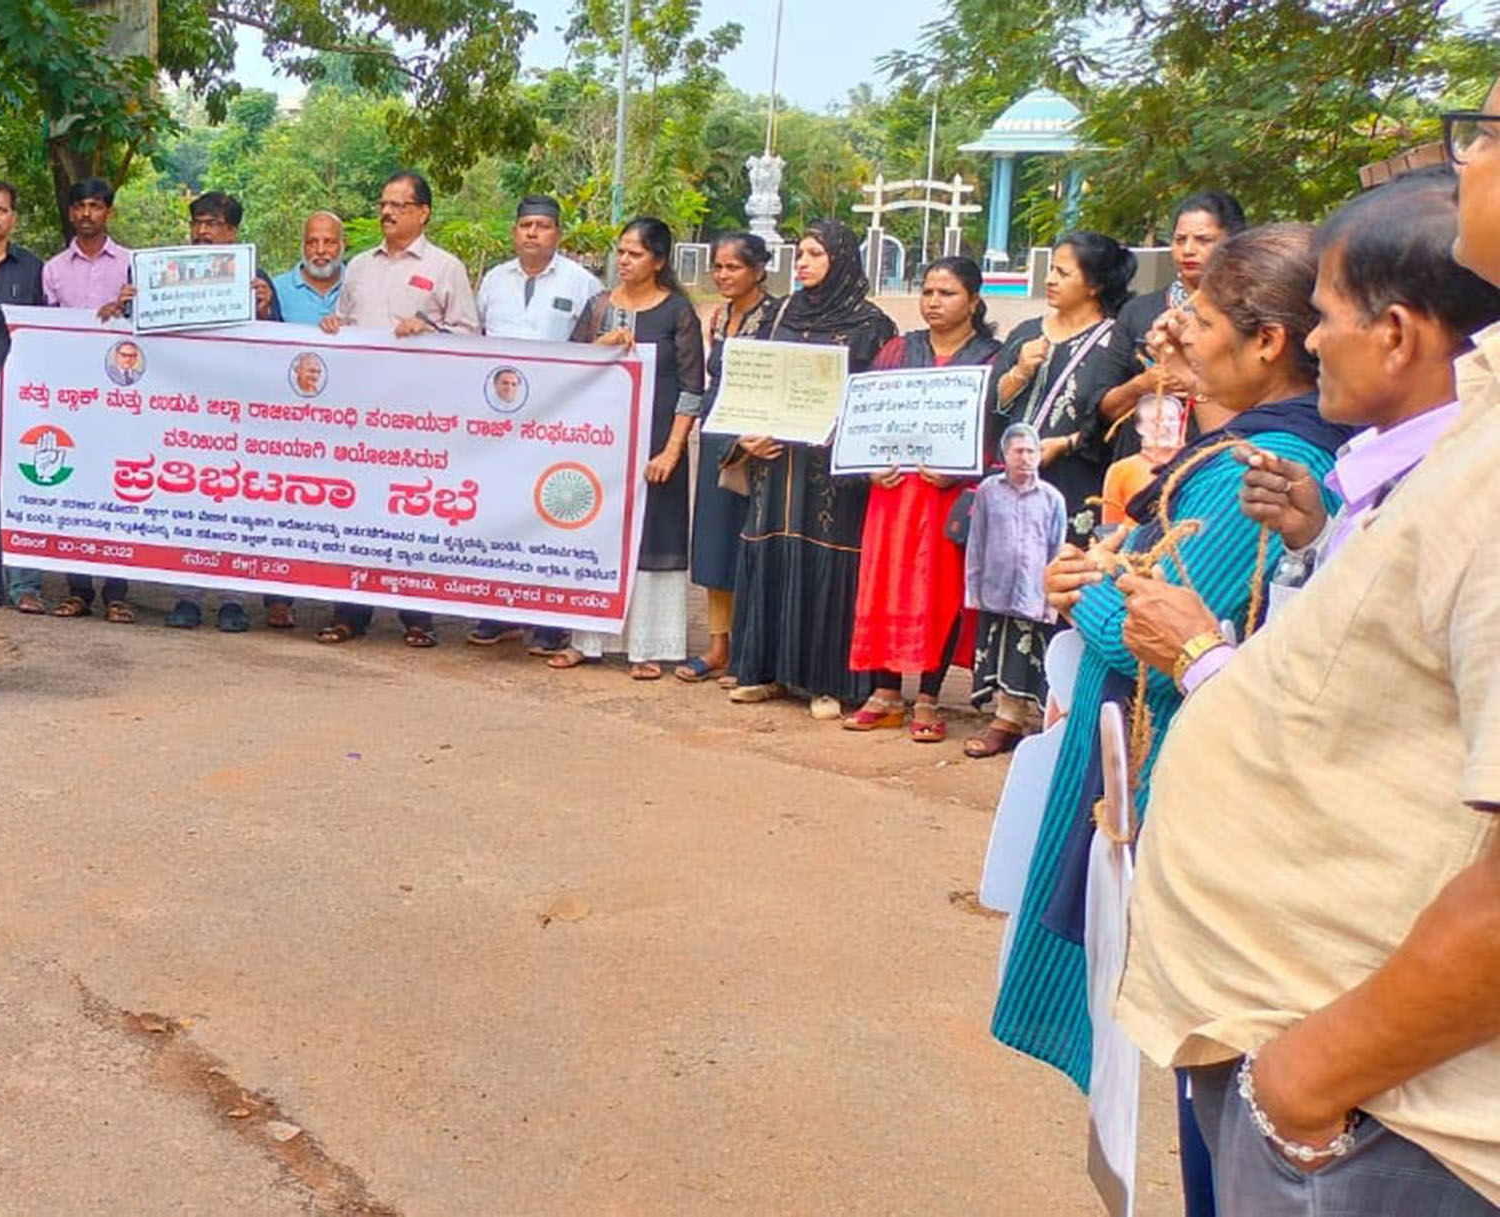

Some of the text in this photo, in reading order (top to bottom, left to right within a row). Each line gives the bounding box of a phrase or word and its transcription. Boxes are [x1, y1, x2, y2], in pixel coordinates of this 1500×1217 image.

[57, 387, 99, 411] ಬ್ಲಾಕ್
[106, 388, 141, 415] ಮತ್ತು
[150, 393, 199, 413] ಉಡುಪಿ
[206, 397, 241, 423] ಜಿಲ್ಲಾ
[365, 407, 458, 433] ಪಂಚಾಯತ್
[466, 416, 513, 438] ರಾಜ್
[520, 419, 615, 447] ಸಂಘಟನೆಯ
[163, 428, 448, 470] ವತಿಯಿಂದ ಜಂಟಿಯಾಗಿ ಆಯೋಜಿಸಿರುವ
[113, 452, 480, 525] ಪ್ರತಿಭಟನಾ ಸಭೆ
